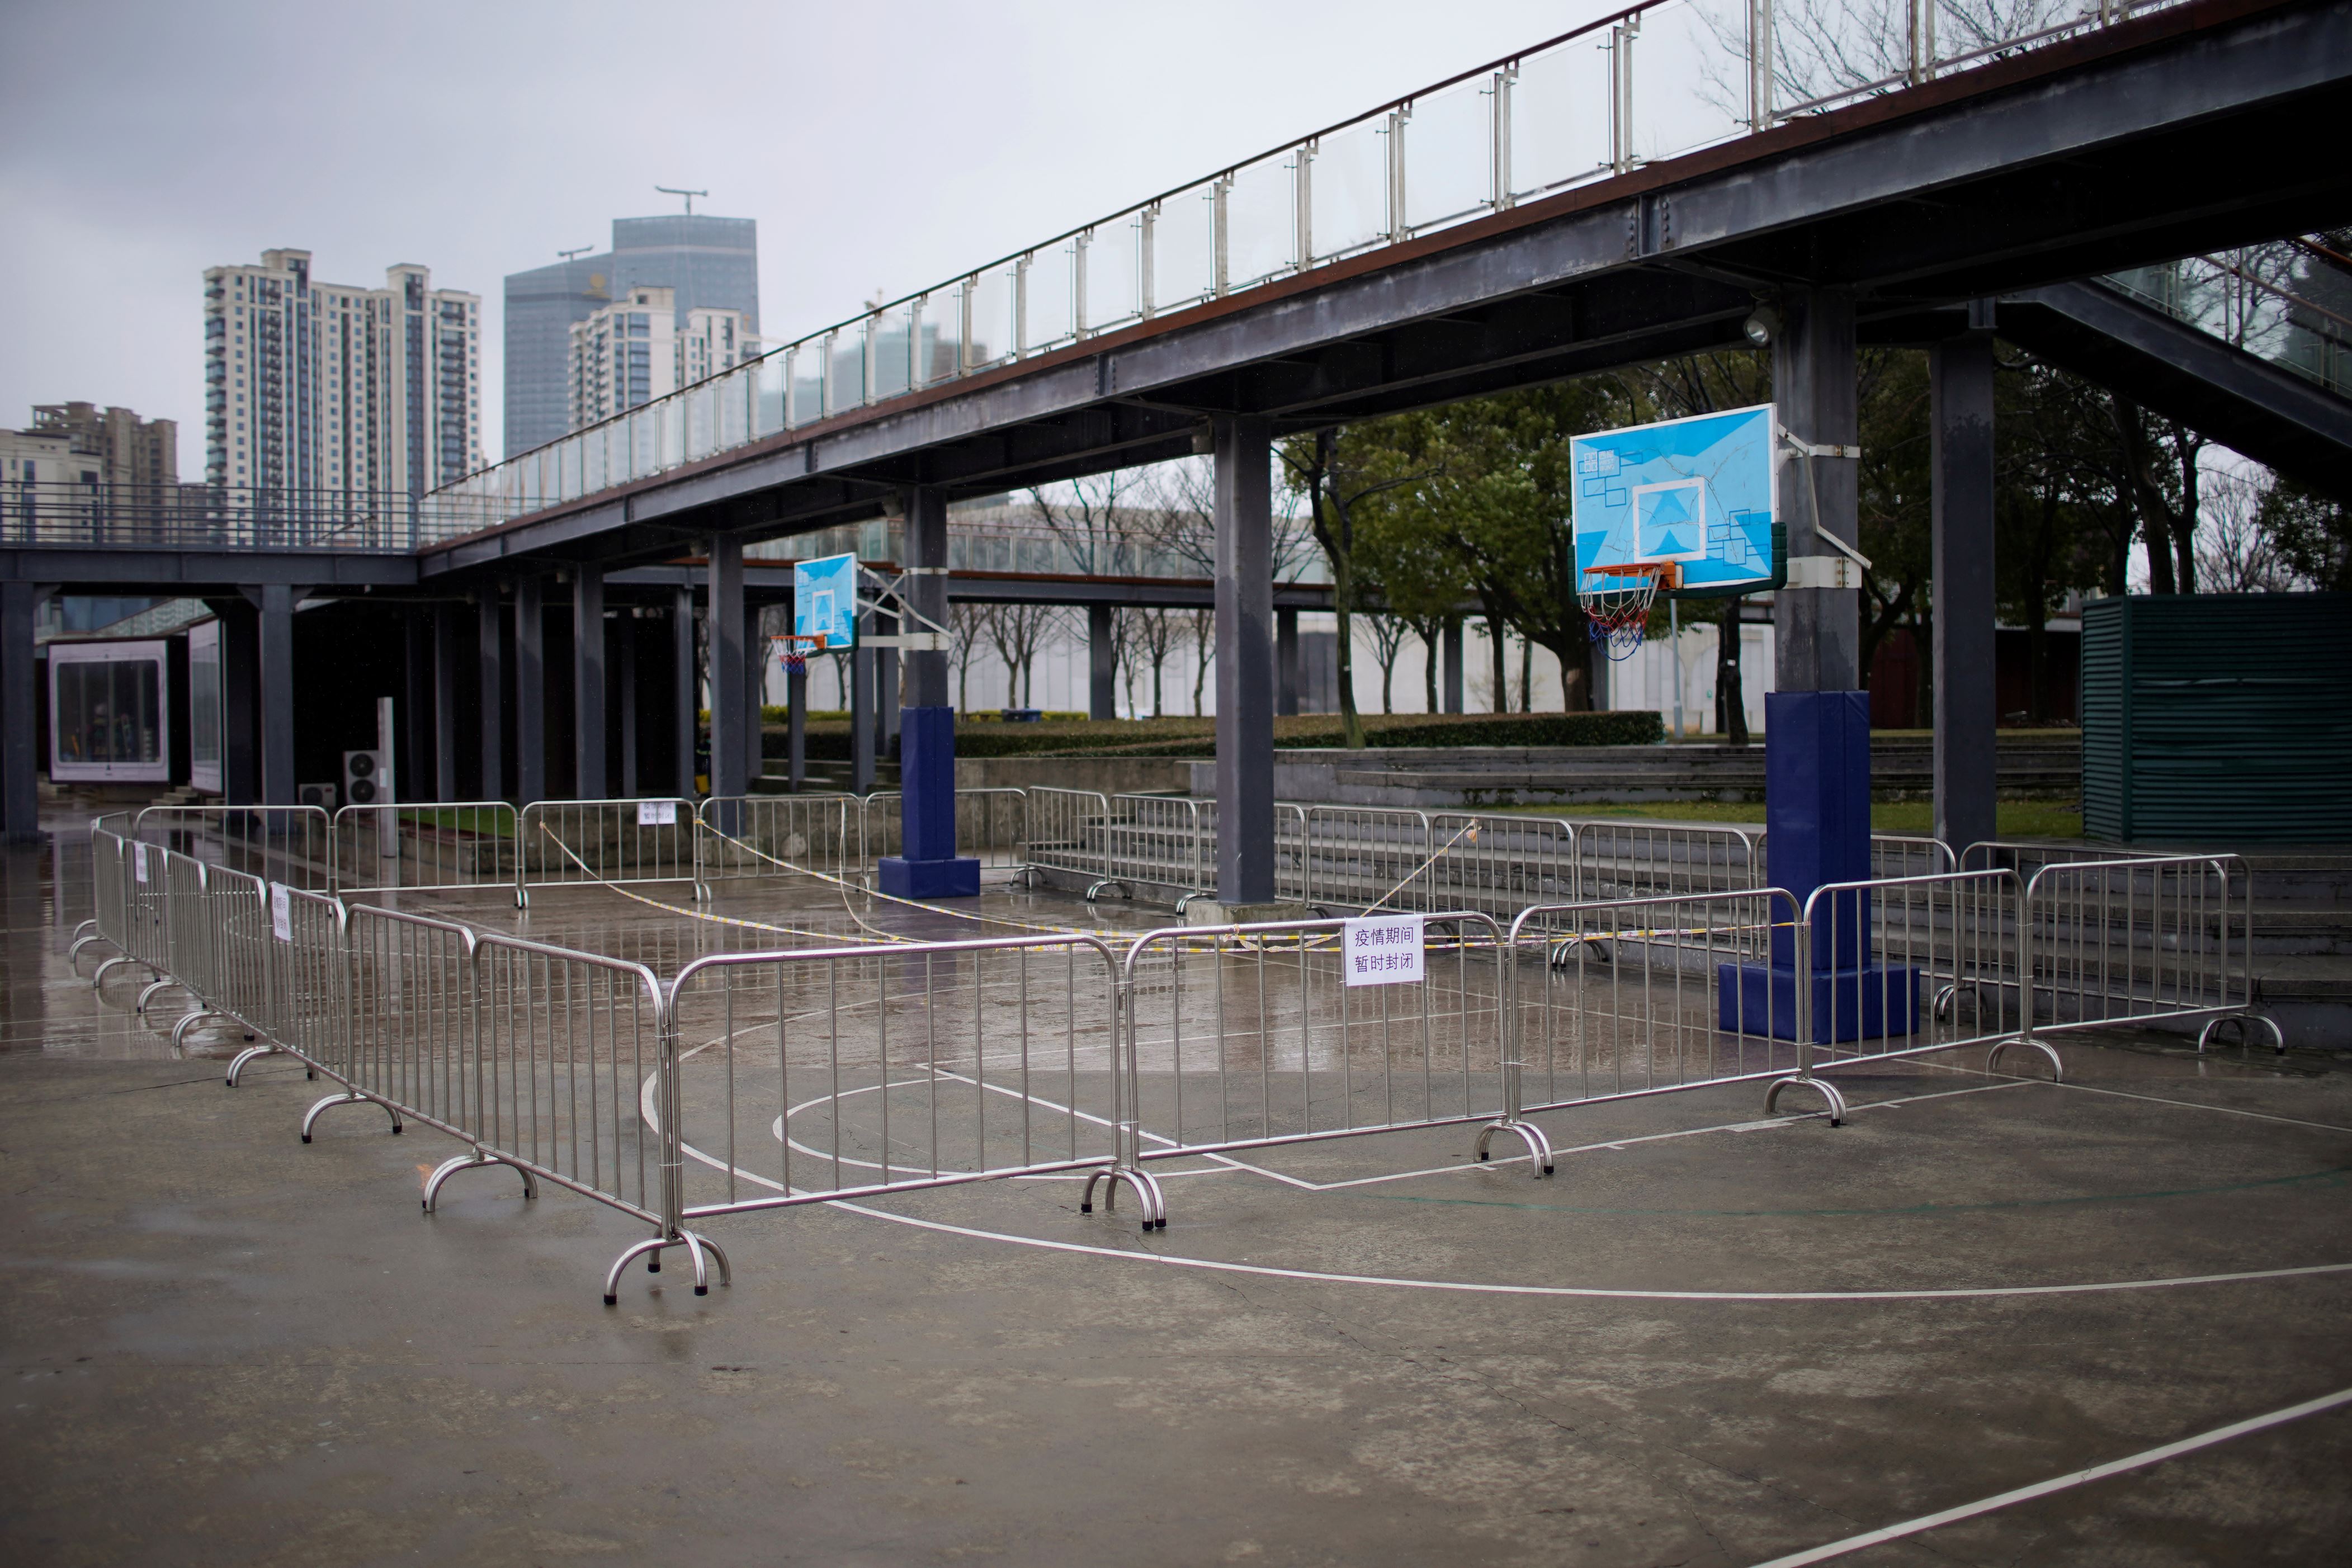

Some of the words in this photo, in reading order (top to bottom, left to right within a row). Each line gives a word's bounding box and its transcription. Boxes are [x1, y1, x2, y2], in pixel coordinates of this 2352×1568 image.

[1355, 927, 1414, 947] 疫情期间
[1355, 952, 1413, 973] 暂时封闭
